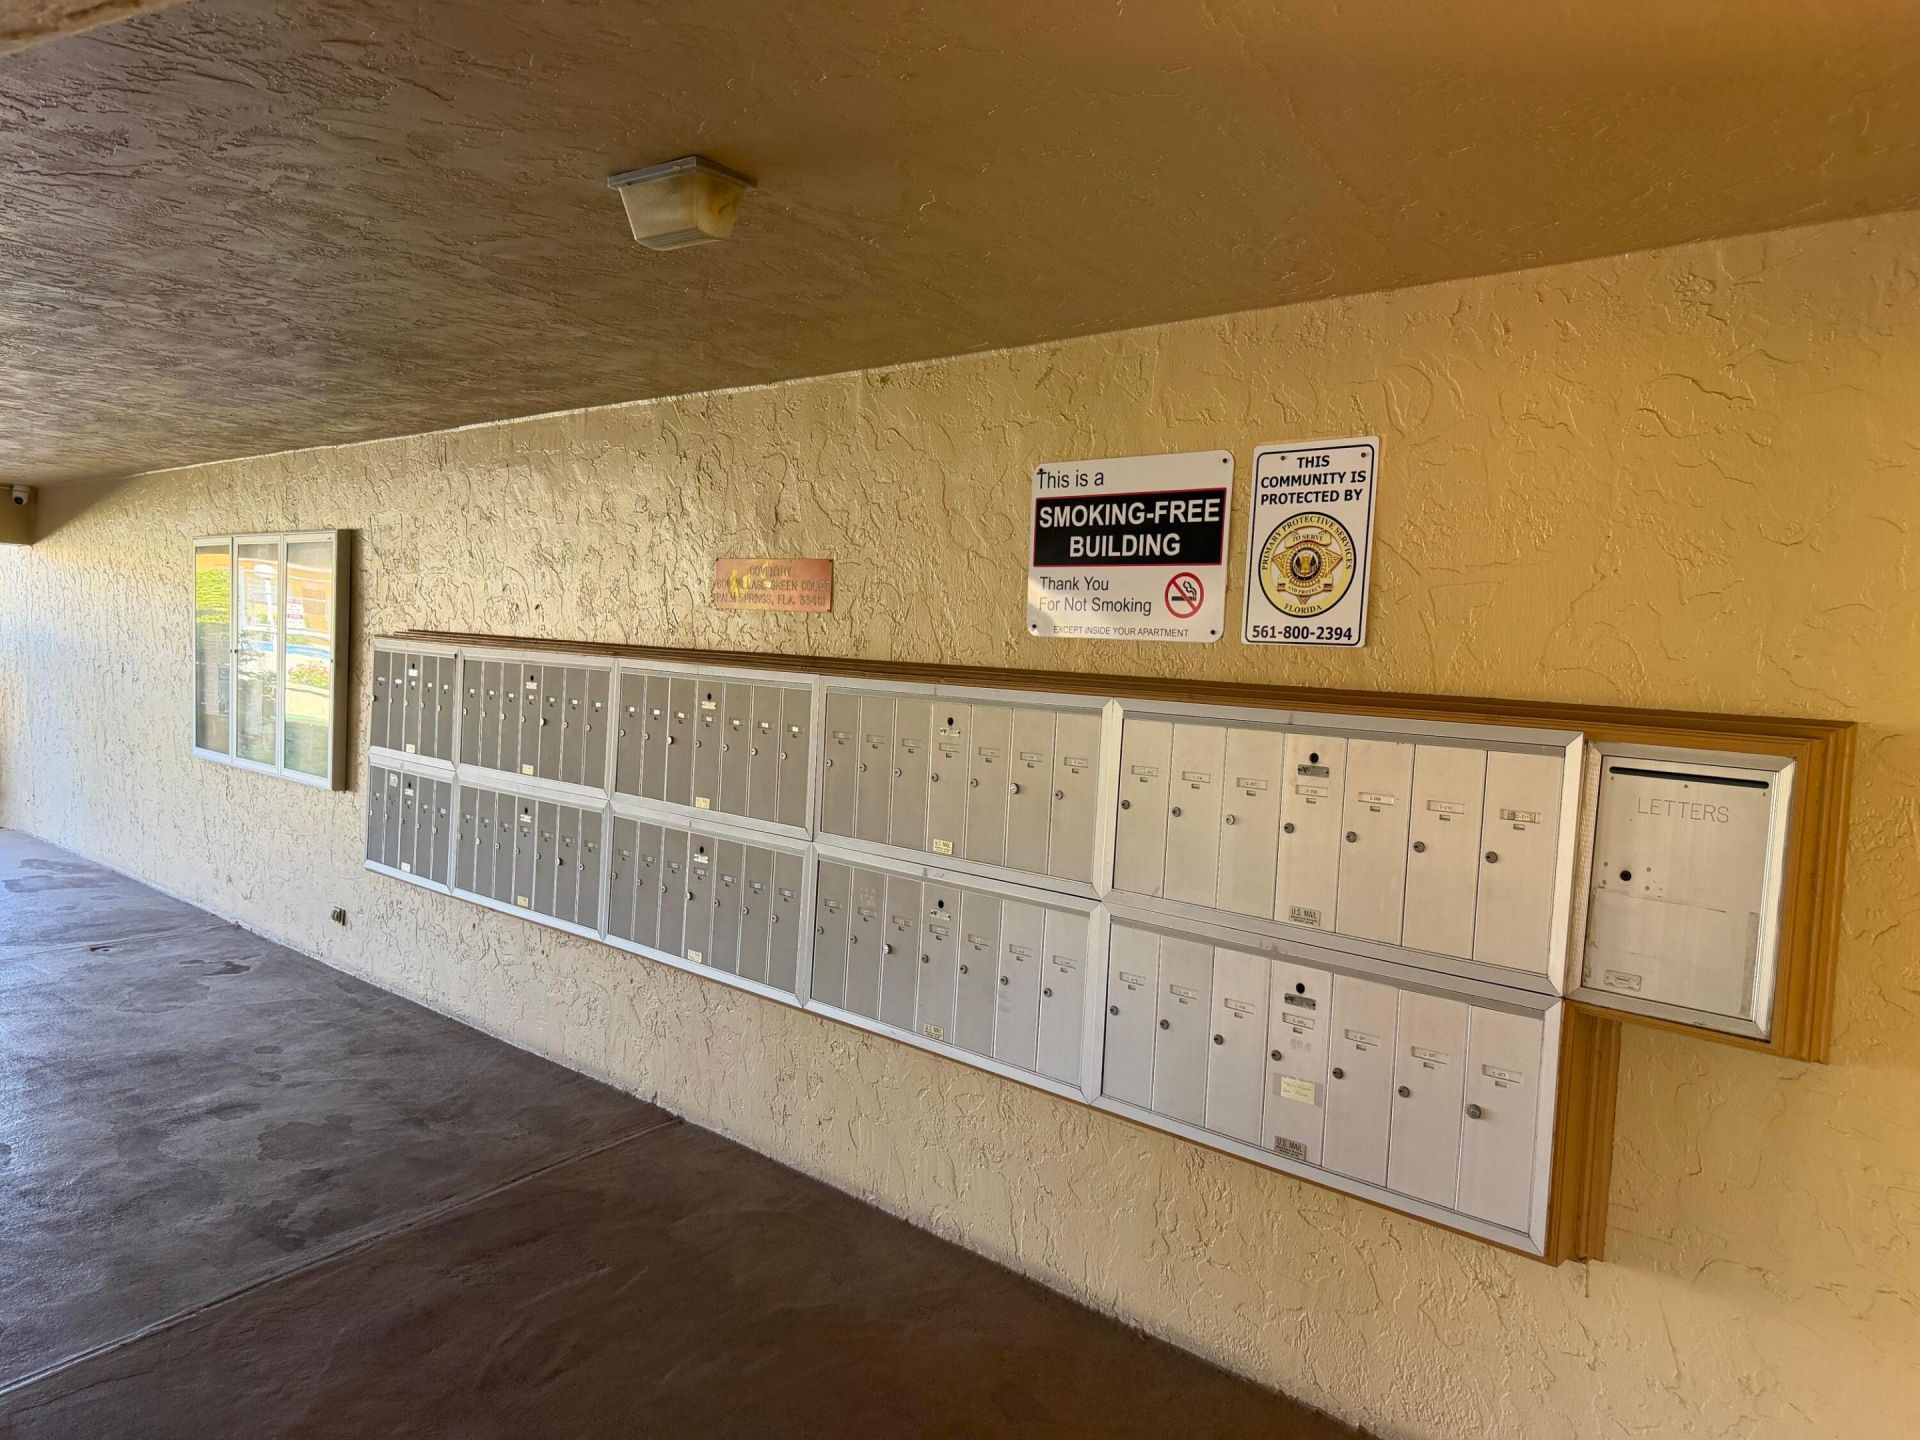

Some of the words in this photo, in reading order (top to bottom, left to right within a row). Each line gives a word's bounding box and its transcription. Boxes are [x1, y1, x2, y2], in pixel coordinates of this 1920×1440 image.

[1296, 455, 1330, 469] THIS
[1037, 469, 1070, 489] This
[1075, 469, 1089, 488] is
[1094, 472, 1105, 487] a
[1260, 471, 1347, 489] COMMUNITY
[1350, 470, 1367, 483] IS
[1260, 490, 1340, 506] PROTECTED
[1344, 488, 1363, 502] BY
[1039, 498, 1221, 528] SMOKING-FREE
[1069, 533, 1181, 558] BUILDING
[1262, 531, 1282, 570] PRIMARY
[1281, 515, 1336, 532] PROTECTIVE
[1334, 527, 1353, 570] SERVICES
[1040, 576, 1080, 591] Thank
[1083, 577, 1110, 592] You
[1039, 597, 1060, 612] For
[1064, 597, 1087, 612] Not
[1091, 597, 1152, 617] Smoking
[1284, 603, 1322, 615] FLORIDA
[1053, 625, 1084, 635] EXCEPT
[1084, 626, 1112, 635] INSIDE
[1113, 627, 1137, 636] YOUR
[1137, 628, 1190, 638] APARTMENT
[1252, 625, 1353, 641] 561-800-2394
[1637, 796, 1730, 824] LETTERS
